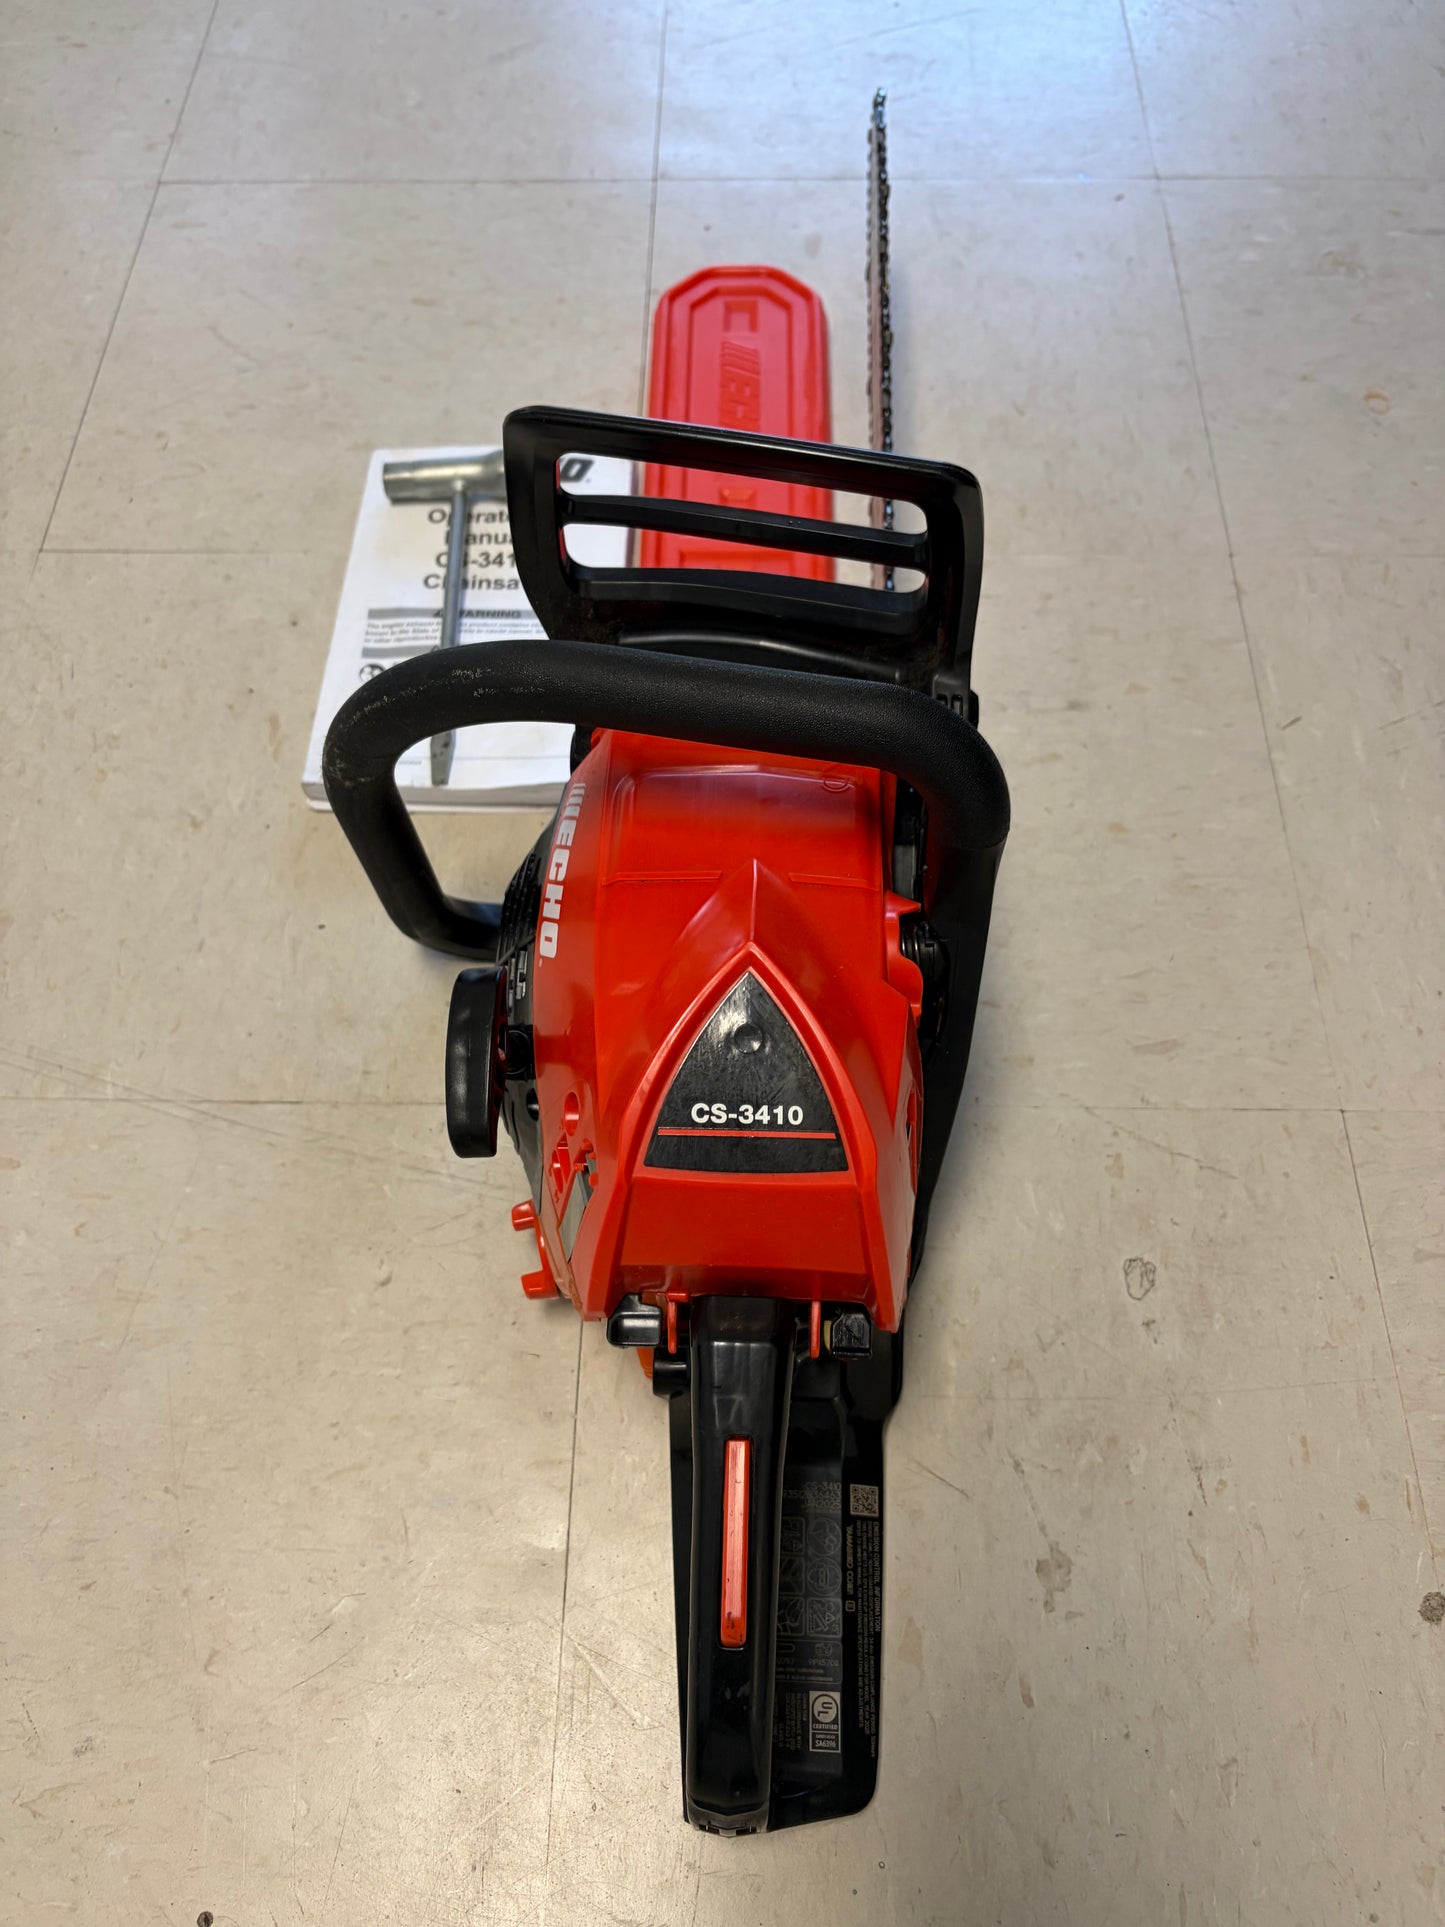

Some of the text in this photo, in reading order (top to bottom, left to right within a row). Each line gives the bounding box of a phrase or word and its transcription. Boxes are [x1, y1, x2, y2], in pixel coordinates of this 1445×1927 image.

[458, 609, 522, 620] ARNING
[540, 820, 577, 958] ECHO
[691, 1103, 803, 1125] CS-3410
